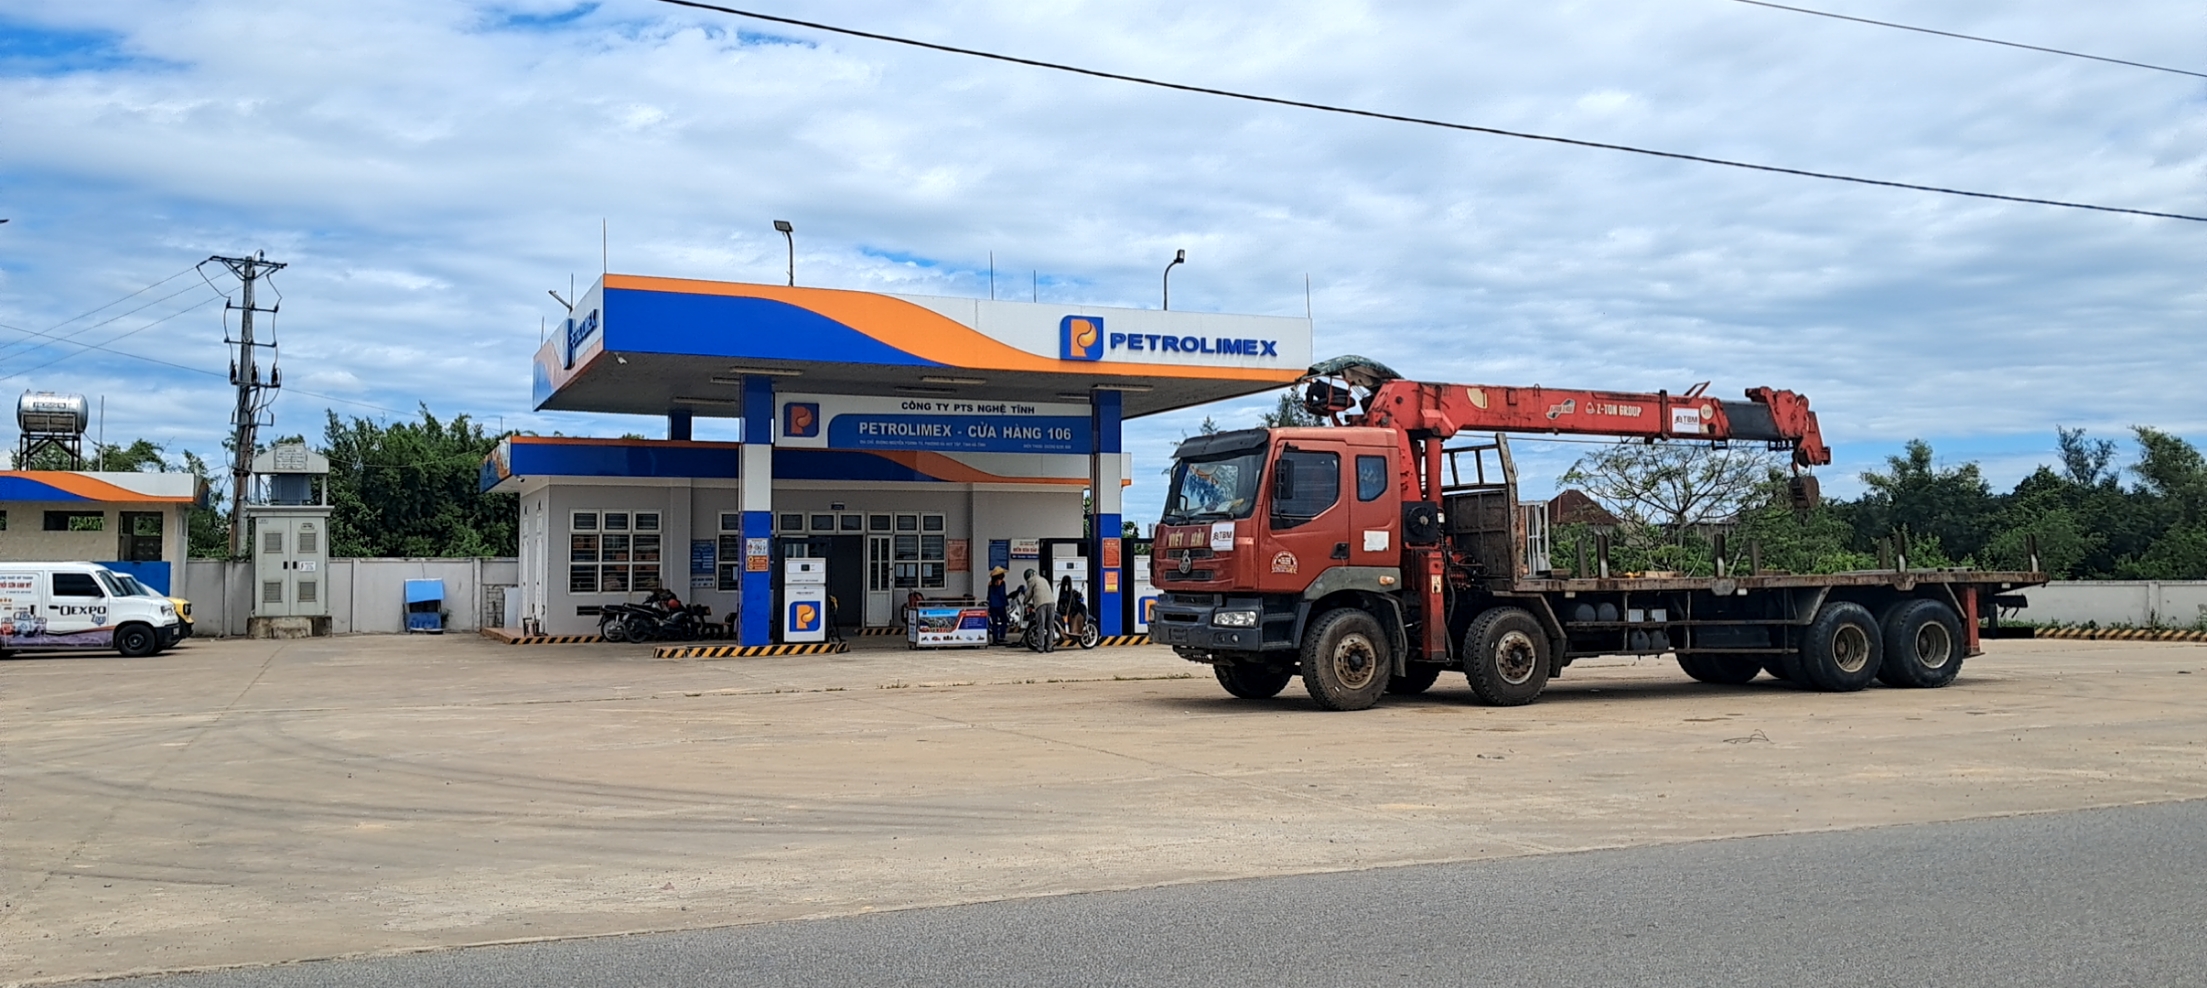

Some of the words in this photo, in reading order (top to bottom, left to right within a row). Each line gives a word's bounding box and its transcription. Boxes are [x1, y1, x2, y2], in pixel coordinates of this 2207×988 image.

[1110, 332, 1278, 357] PETROLIMEX
[901, 401, 932, 411] CÔNG
[936, 403, 950, 412] TY
[954, 404, 973, 413] PTS
[977, 403, 1007, 415] NGHỆ
[1619, 404, 1642, 418] GROUP
[859, 421, 952, 437] PETROLIMEX
[968, 421, 997, 438] CỬA
[1002, 424, 1042, 440] HÀNG
[1047, 427, 1072, 440] 106
[60, 605, 107, 616] OEXPO
